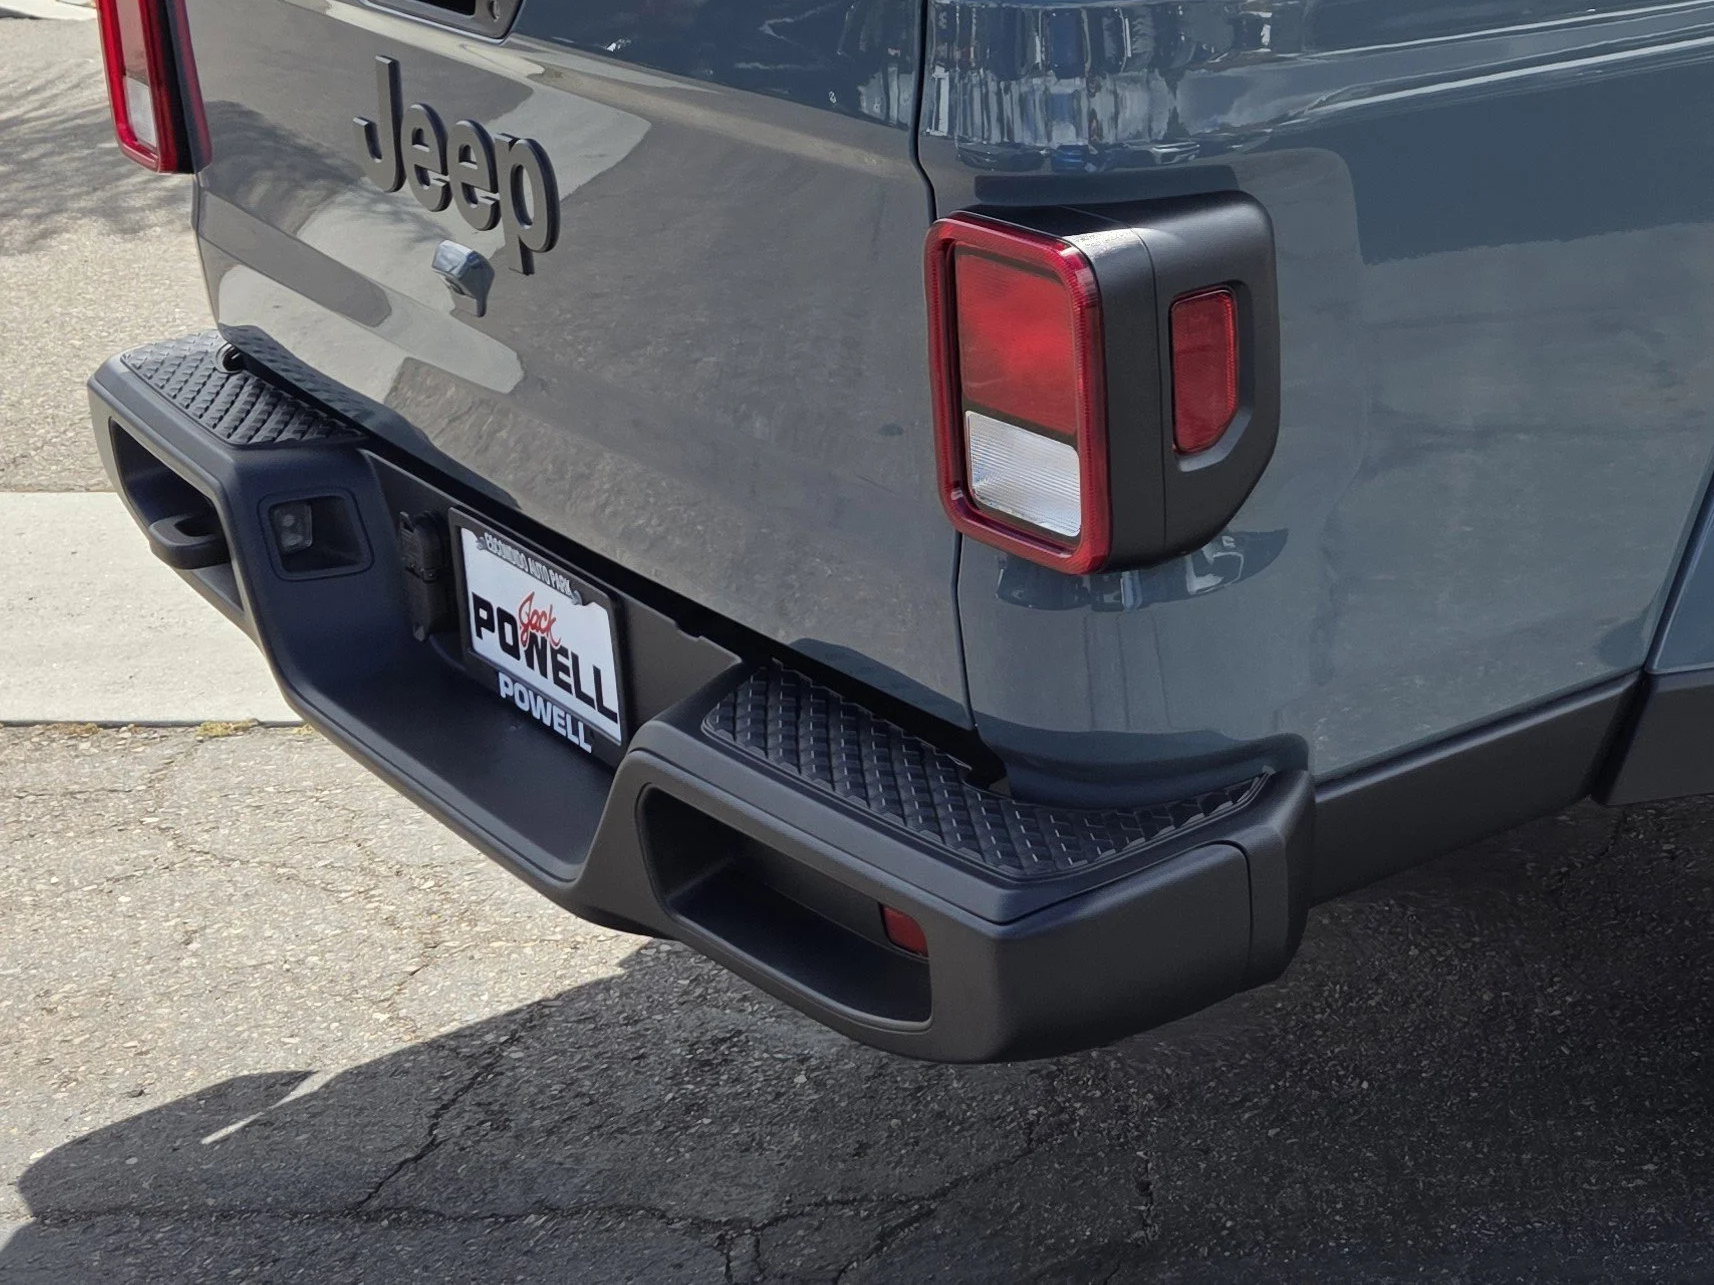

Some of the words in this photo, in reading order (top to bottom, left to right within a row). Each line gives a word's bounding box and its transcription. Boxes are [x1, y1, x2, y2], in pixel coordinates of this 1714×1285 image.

[352, 55, 560, 275] Jeep
[472, 592, 618, 724] POWELL
[518, 591, 561, 649] Jack
[498, 671, 592, 753] POWELL
